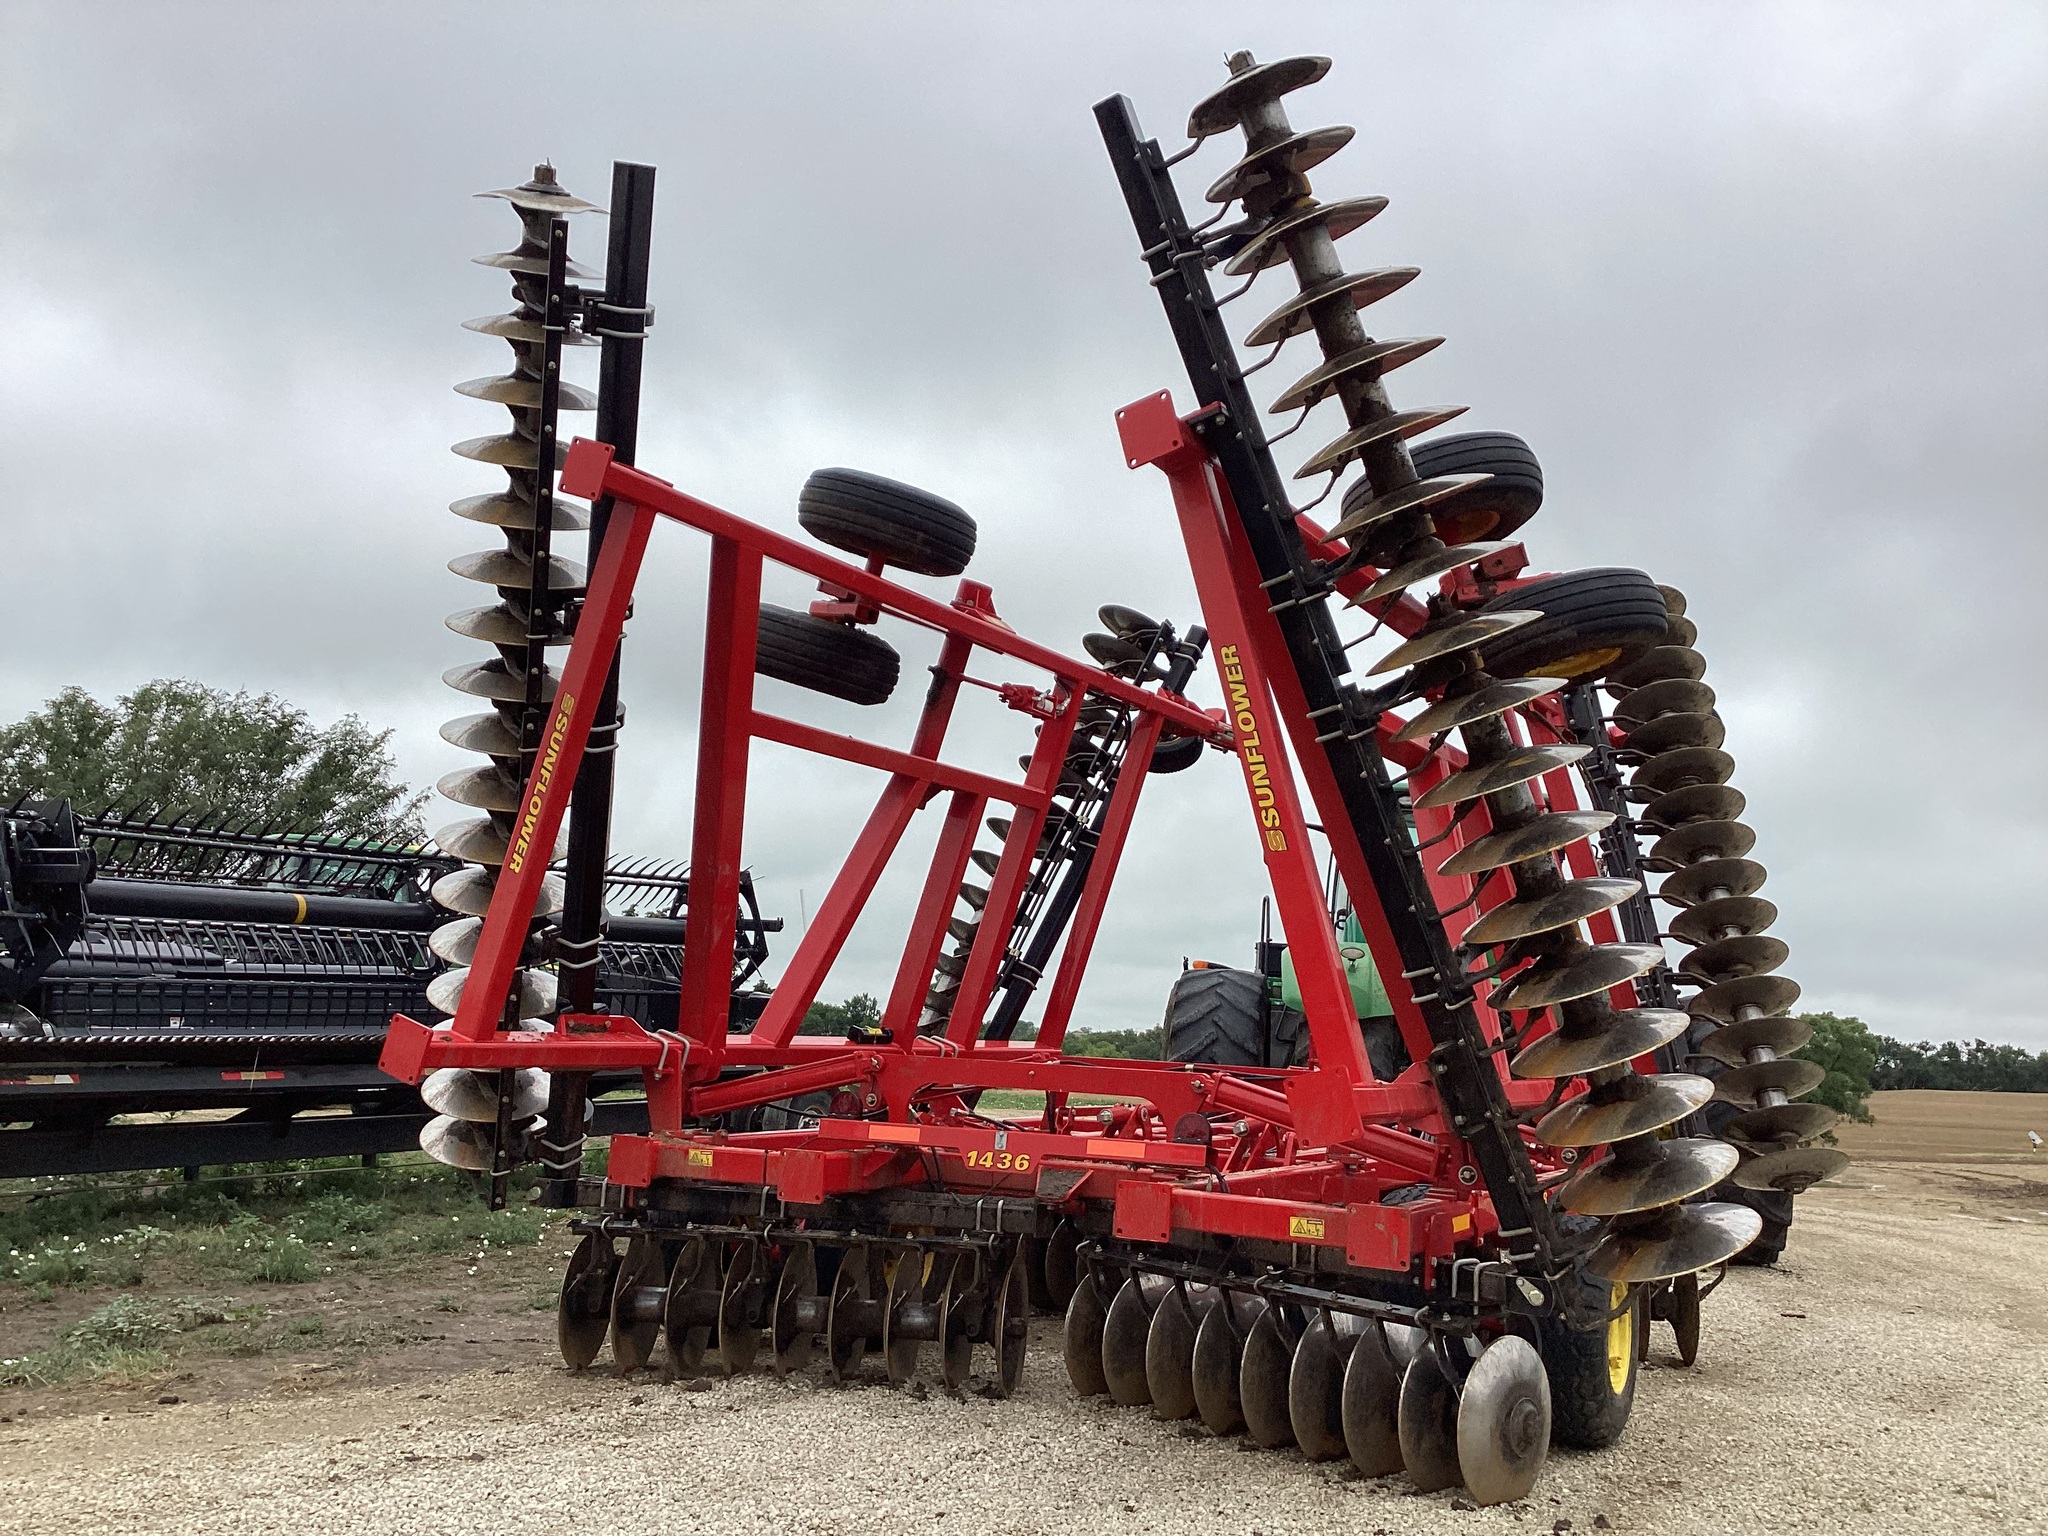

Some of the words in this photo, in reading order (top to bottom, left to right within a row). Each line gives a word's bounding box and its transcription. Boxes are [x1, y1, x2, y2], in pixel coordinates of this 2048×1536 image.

[508, 713, 569, 874] SUNFLOWER
[1220, 643, 1281, 828] SUNFLOWER
[967, 1150, 1030, 1171] 1436
